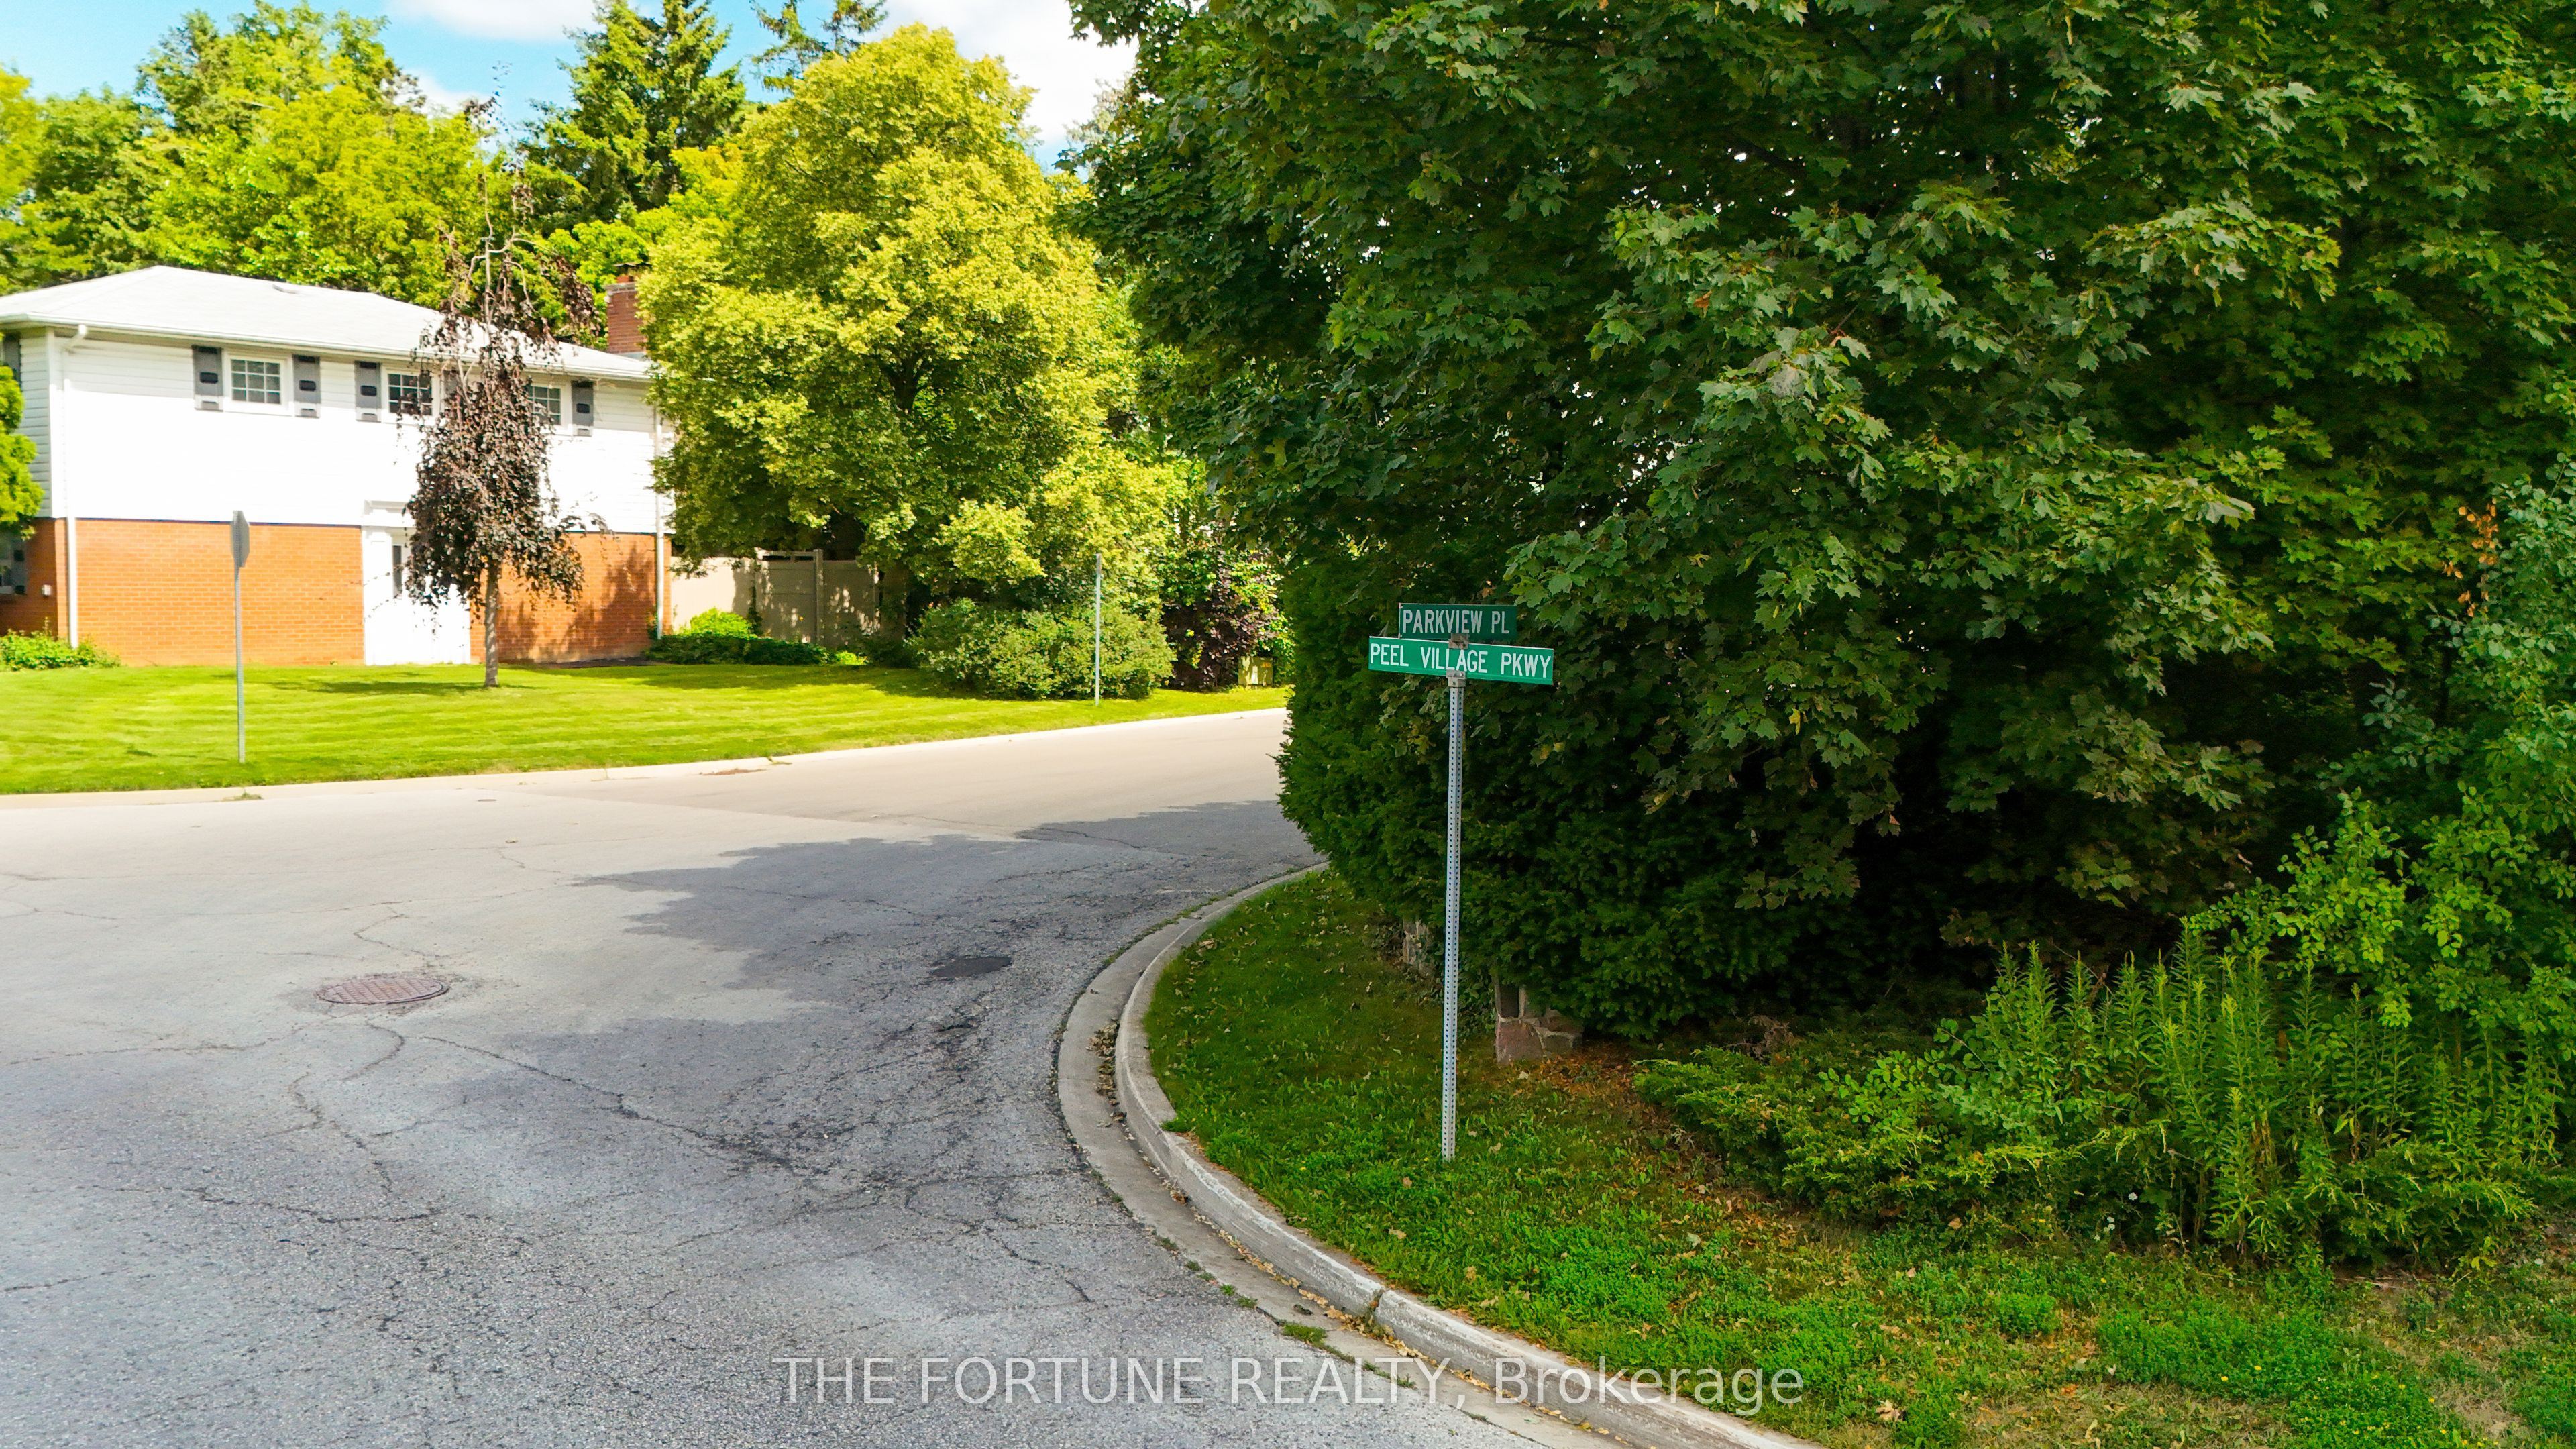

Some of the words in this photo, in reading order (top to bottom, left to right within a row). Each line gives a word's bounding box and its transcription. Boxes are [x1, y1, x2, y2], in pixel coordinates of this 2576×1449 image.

[1403, 609, 1483, 634] PARKVIEW
[1491, 610, 1509, 634] PL
[1370, 643, 1409, 667] PEEL
[1420, 647, 1488, 673] VILLAGE
[1501, 653, 1551, 678] PKWY
